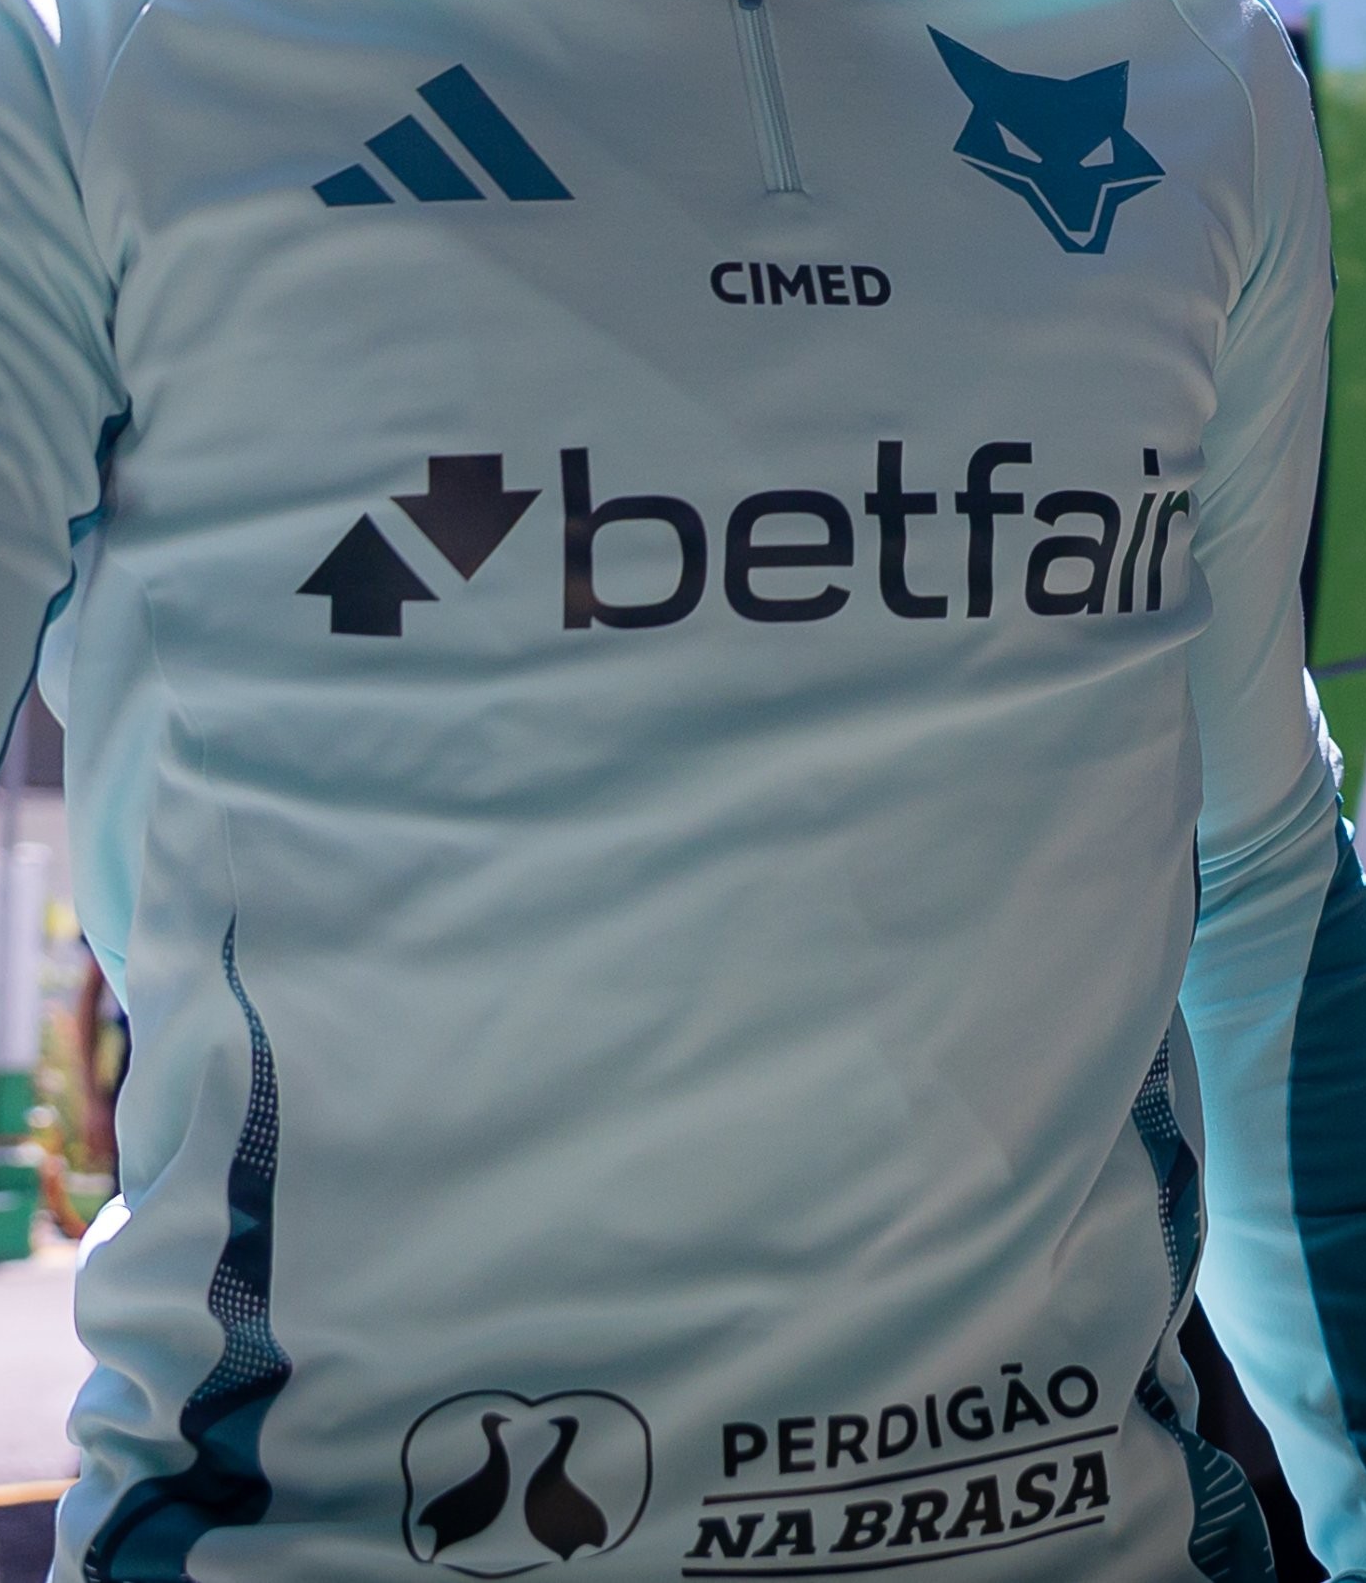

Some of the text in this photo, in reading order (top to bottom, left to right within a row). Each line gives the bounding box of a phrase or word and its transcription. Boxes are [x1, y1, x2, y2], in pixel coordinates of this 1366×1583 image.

[710, 262, 892, 307] CIMED
[560, 440, 1190, 630] betfair
[723, 1363, 1099, 1478] PERDIGÃO
[684, 1450, 1111, 1558] NA BRASA
